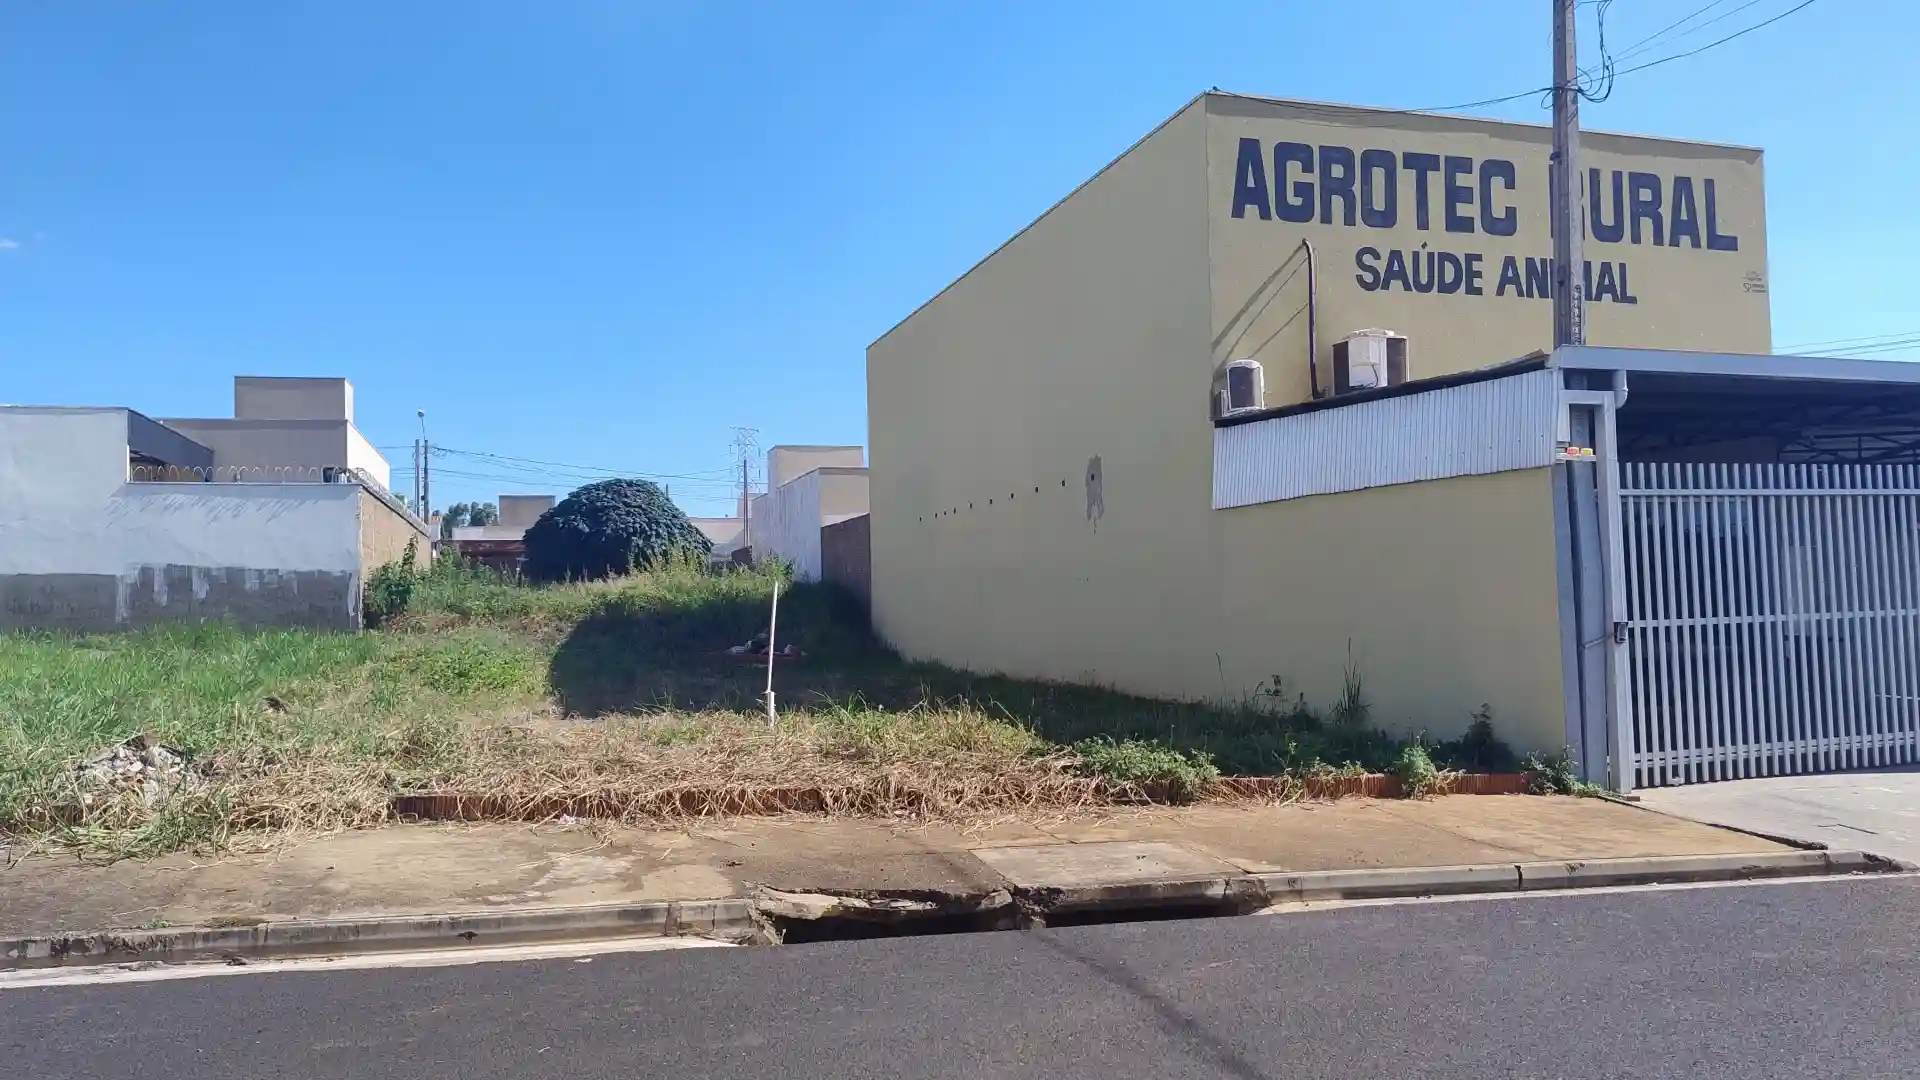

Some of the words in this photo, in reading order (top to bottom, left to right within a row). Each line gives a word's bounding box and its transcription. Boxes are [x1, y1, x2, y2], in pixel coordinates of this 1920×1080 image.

[1231, 137, 1517, 236] AGROTEC
[1548, 162, 1738, 251] URAL
[1355, 241, 1483, 295] SAÚDE
